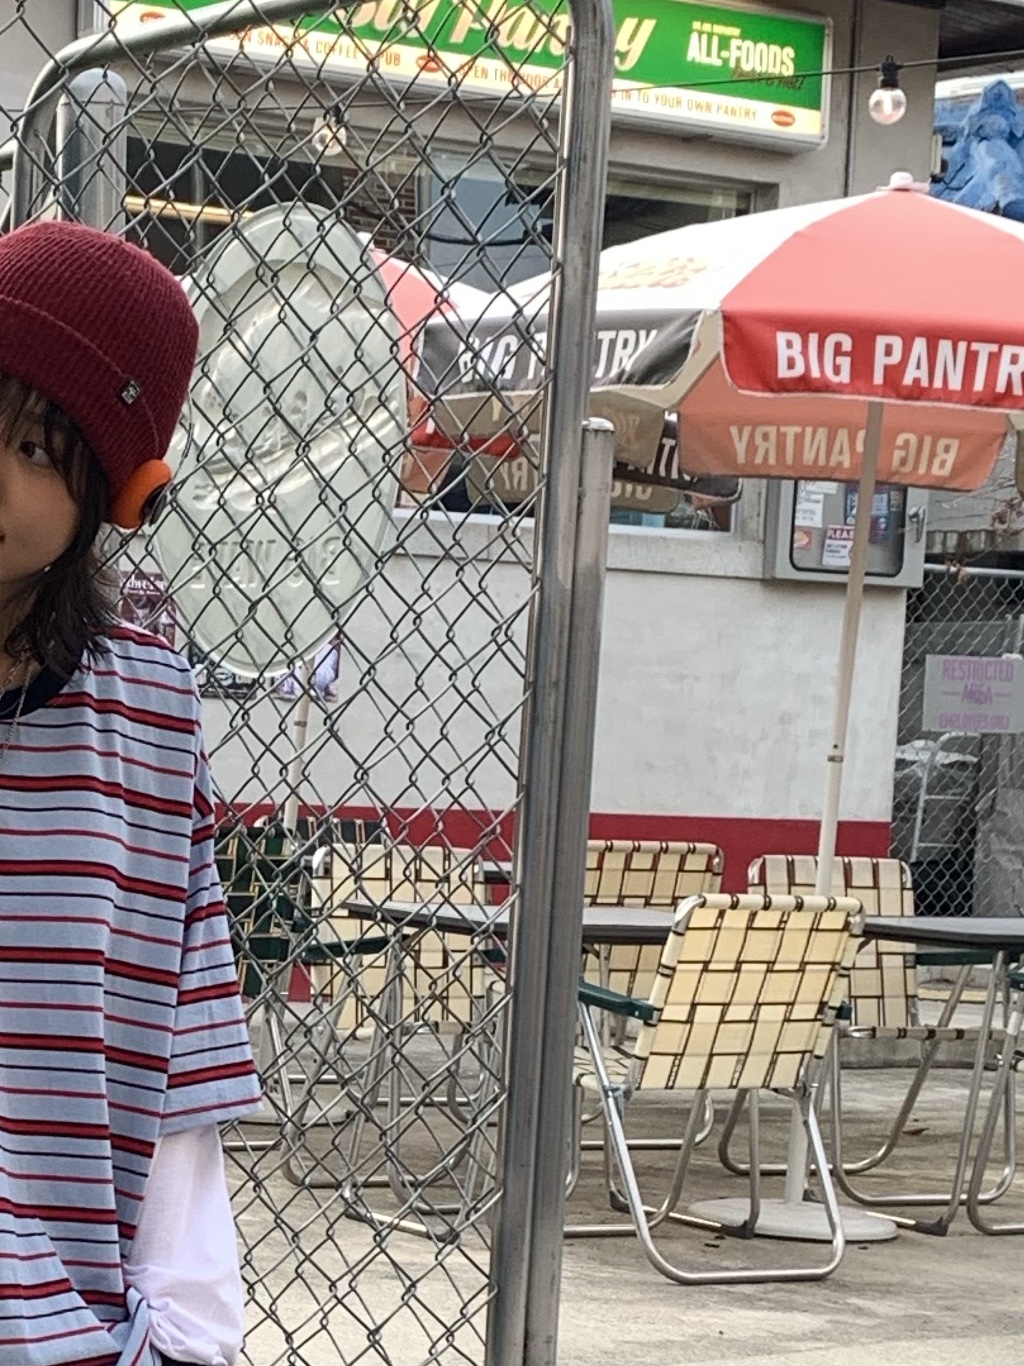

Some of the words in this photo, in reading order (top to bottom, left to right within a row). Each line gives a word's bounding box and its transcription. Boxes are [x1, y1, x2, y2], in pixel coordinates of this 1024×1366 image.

[686, 31, 795, 77] ALL-FOODS
[655, 94, 682, 109] YOUR
[687, 99, 713, 113] OWN
[716, 103, 758, 120] PANTRY
[775, 330, 853, 384] BIG
